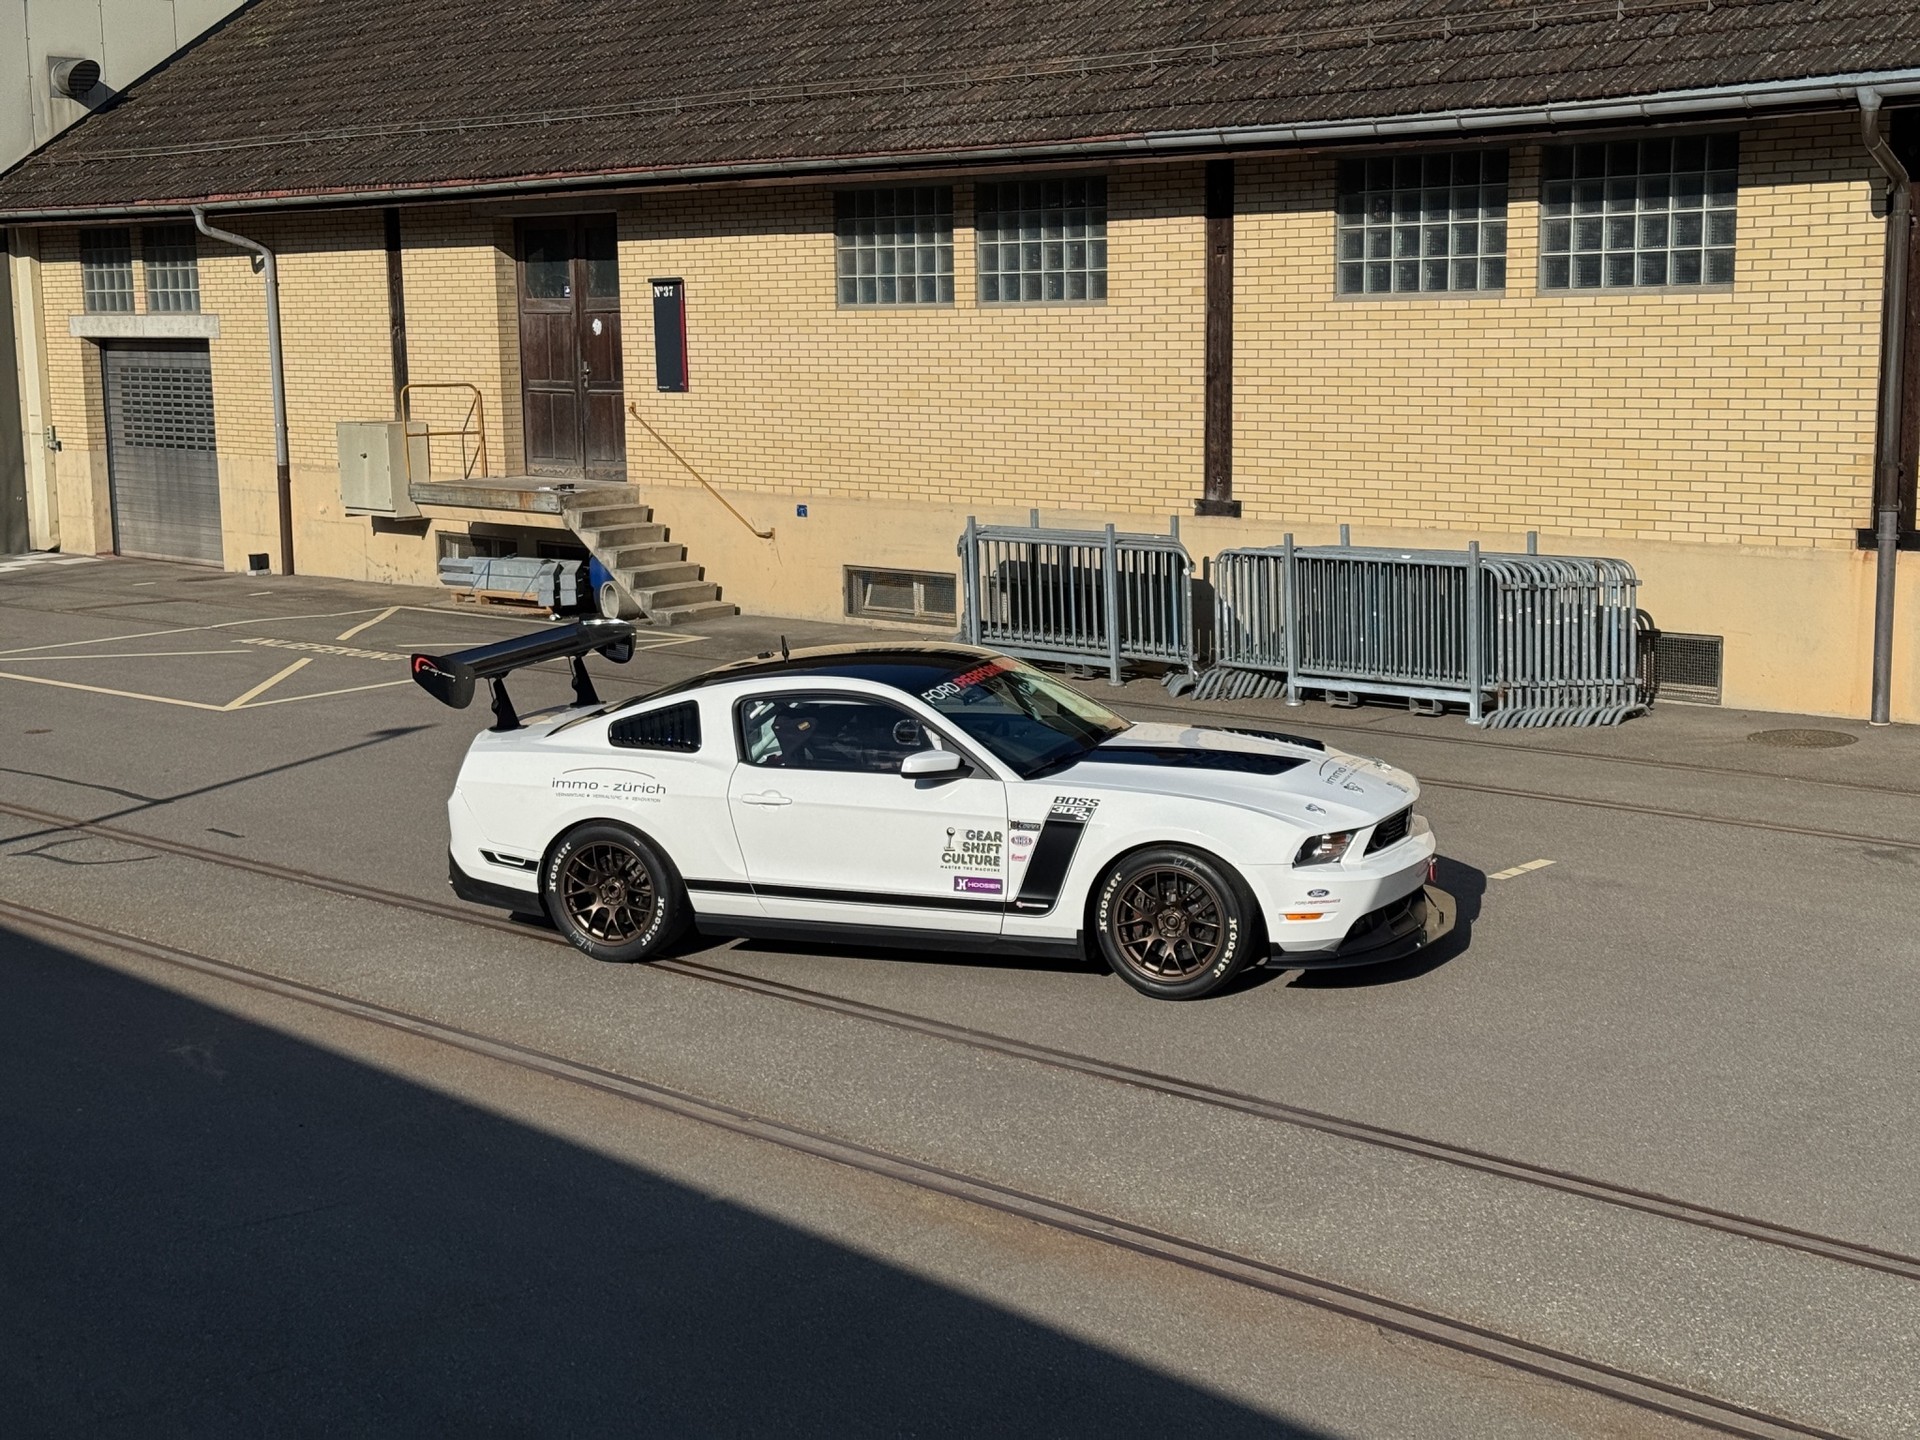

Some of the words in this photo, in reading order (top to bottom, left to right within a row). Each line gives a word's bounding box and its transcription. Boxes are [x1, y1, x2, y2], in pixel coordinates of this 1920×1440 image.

[921, 682, 960, 704] FORD
[552, 777, 599, 790] immo
[612, 782, 667, 795] zürich
[1053, 796, 1101, 807] BOSS
[965, 829, 1003, 843] GEAR
[962, 841, 1002, 855] SHIFT
[549, 842, 572, 893] Hoosier
[941, 852, 1001, 867] CULTURE
[967, 882, 1001, 890] HOOSIER
[1099, 872, 1122, 933] Hoosier
[641, 895, 665, 946] Hoosier
[1212, 916, 1237, 978] Hoosier
